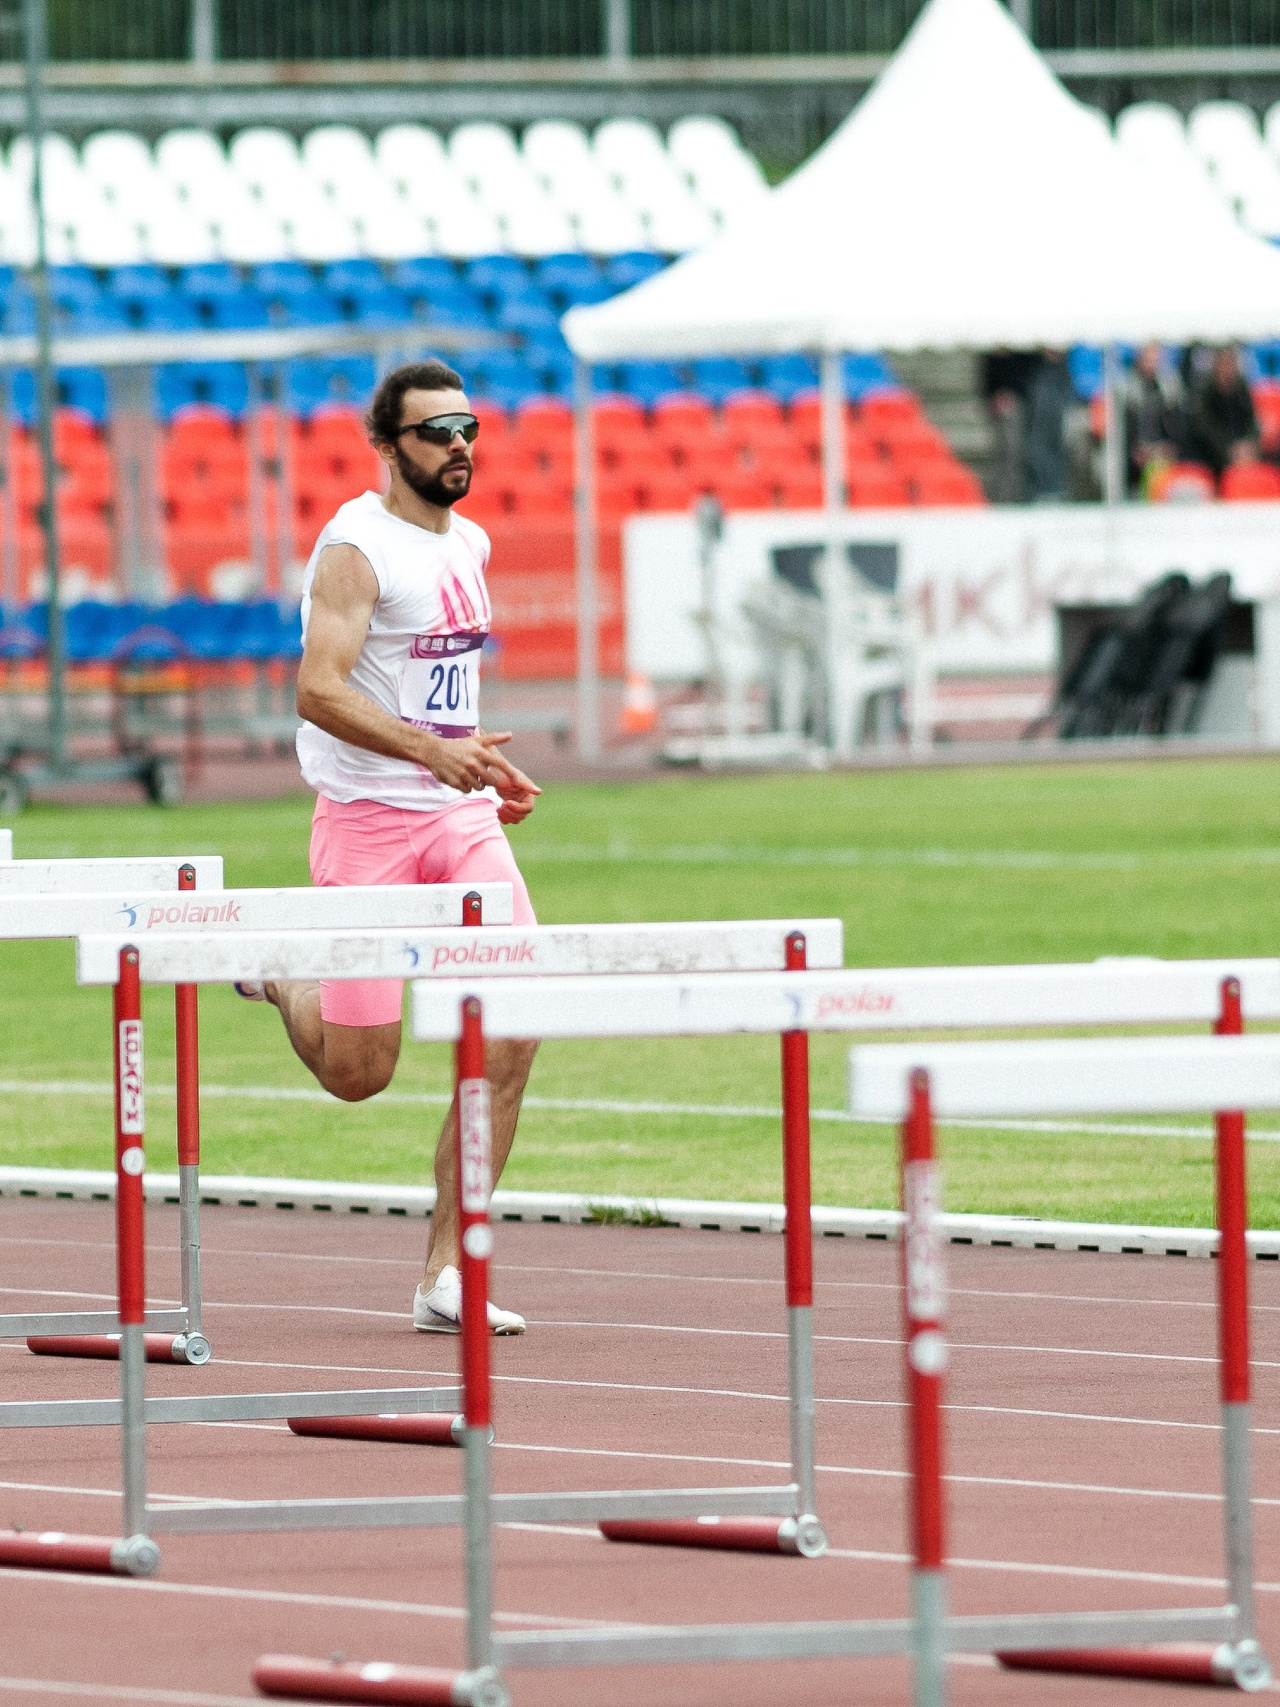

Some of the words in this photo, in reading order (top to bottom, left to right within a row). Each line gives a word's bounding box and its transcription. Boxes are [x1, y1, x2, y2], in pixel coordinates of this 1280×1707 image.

[426, 663, 470, 711] 201
[146, 901, 242, 929] polanik
[432, 940, 536, 969] polanik
